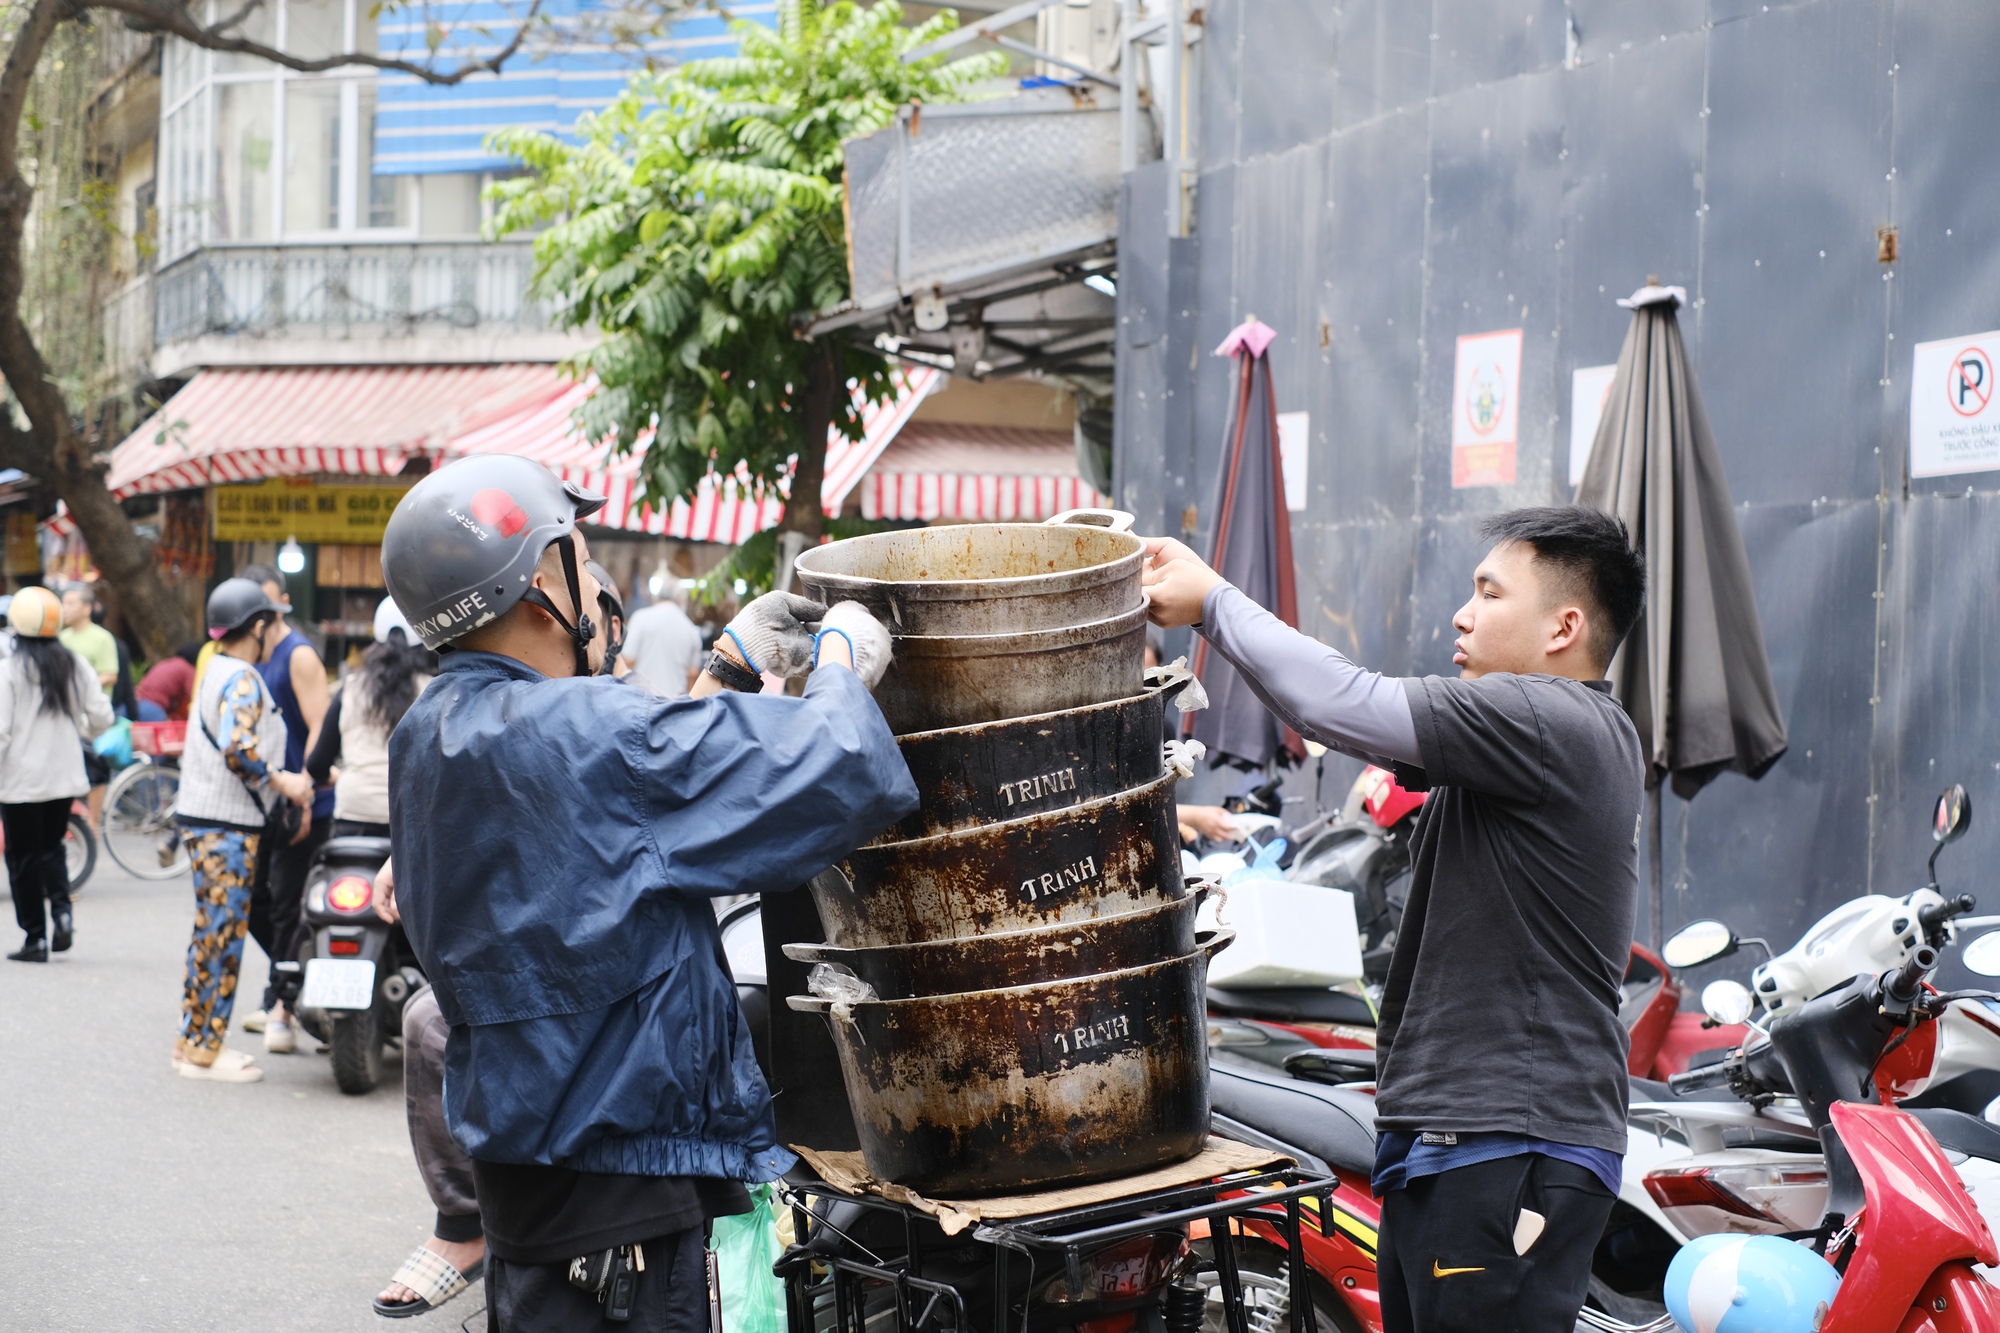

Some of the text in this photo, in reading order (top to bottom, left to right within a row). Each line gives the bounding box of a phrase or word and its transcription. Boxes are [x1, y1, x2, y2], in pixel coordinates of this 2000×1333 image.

[413, 591, 487, 638] OKYOLIFE
[997, 767, 1076, 806] TRINH
[1020, 855, 1098, 901] TRINH
